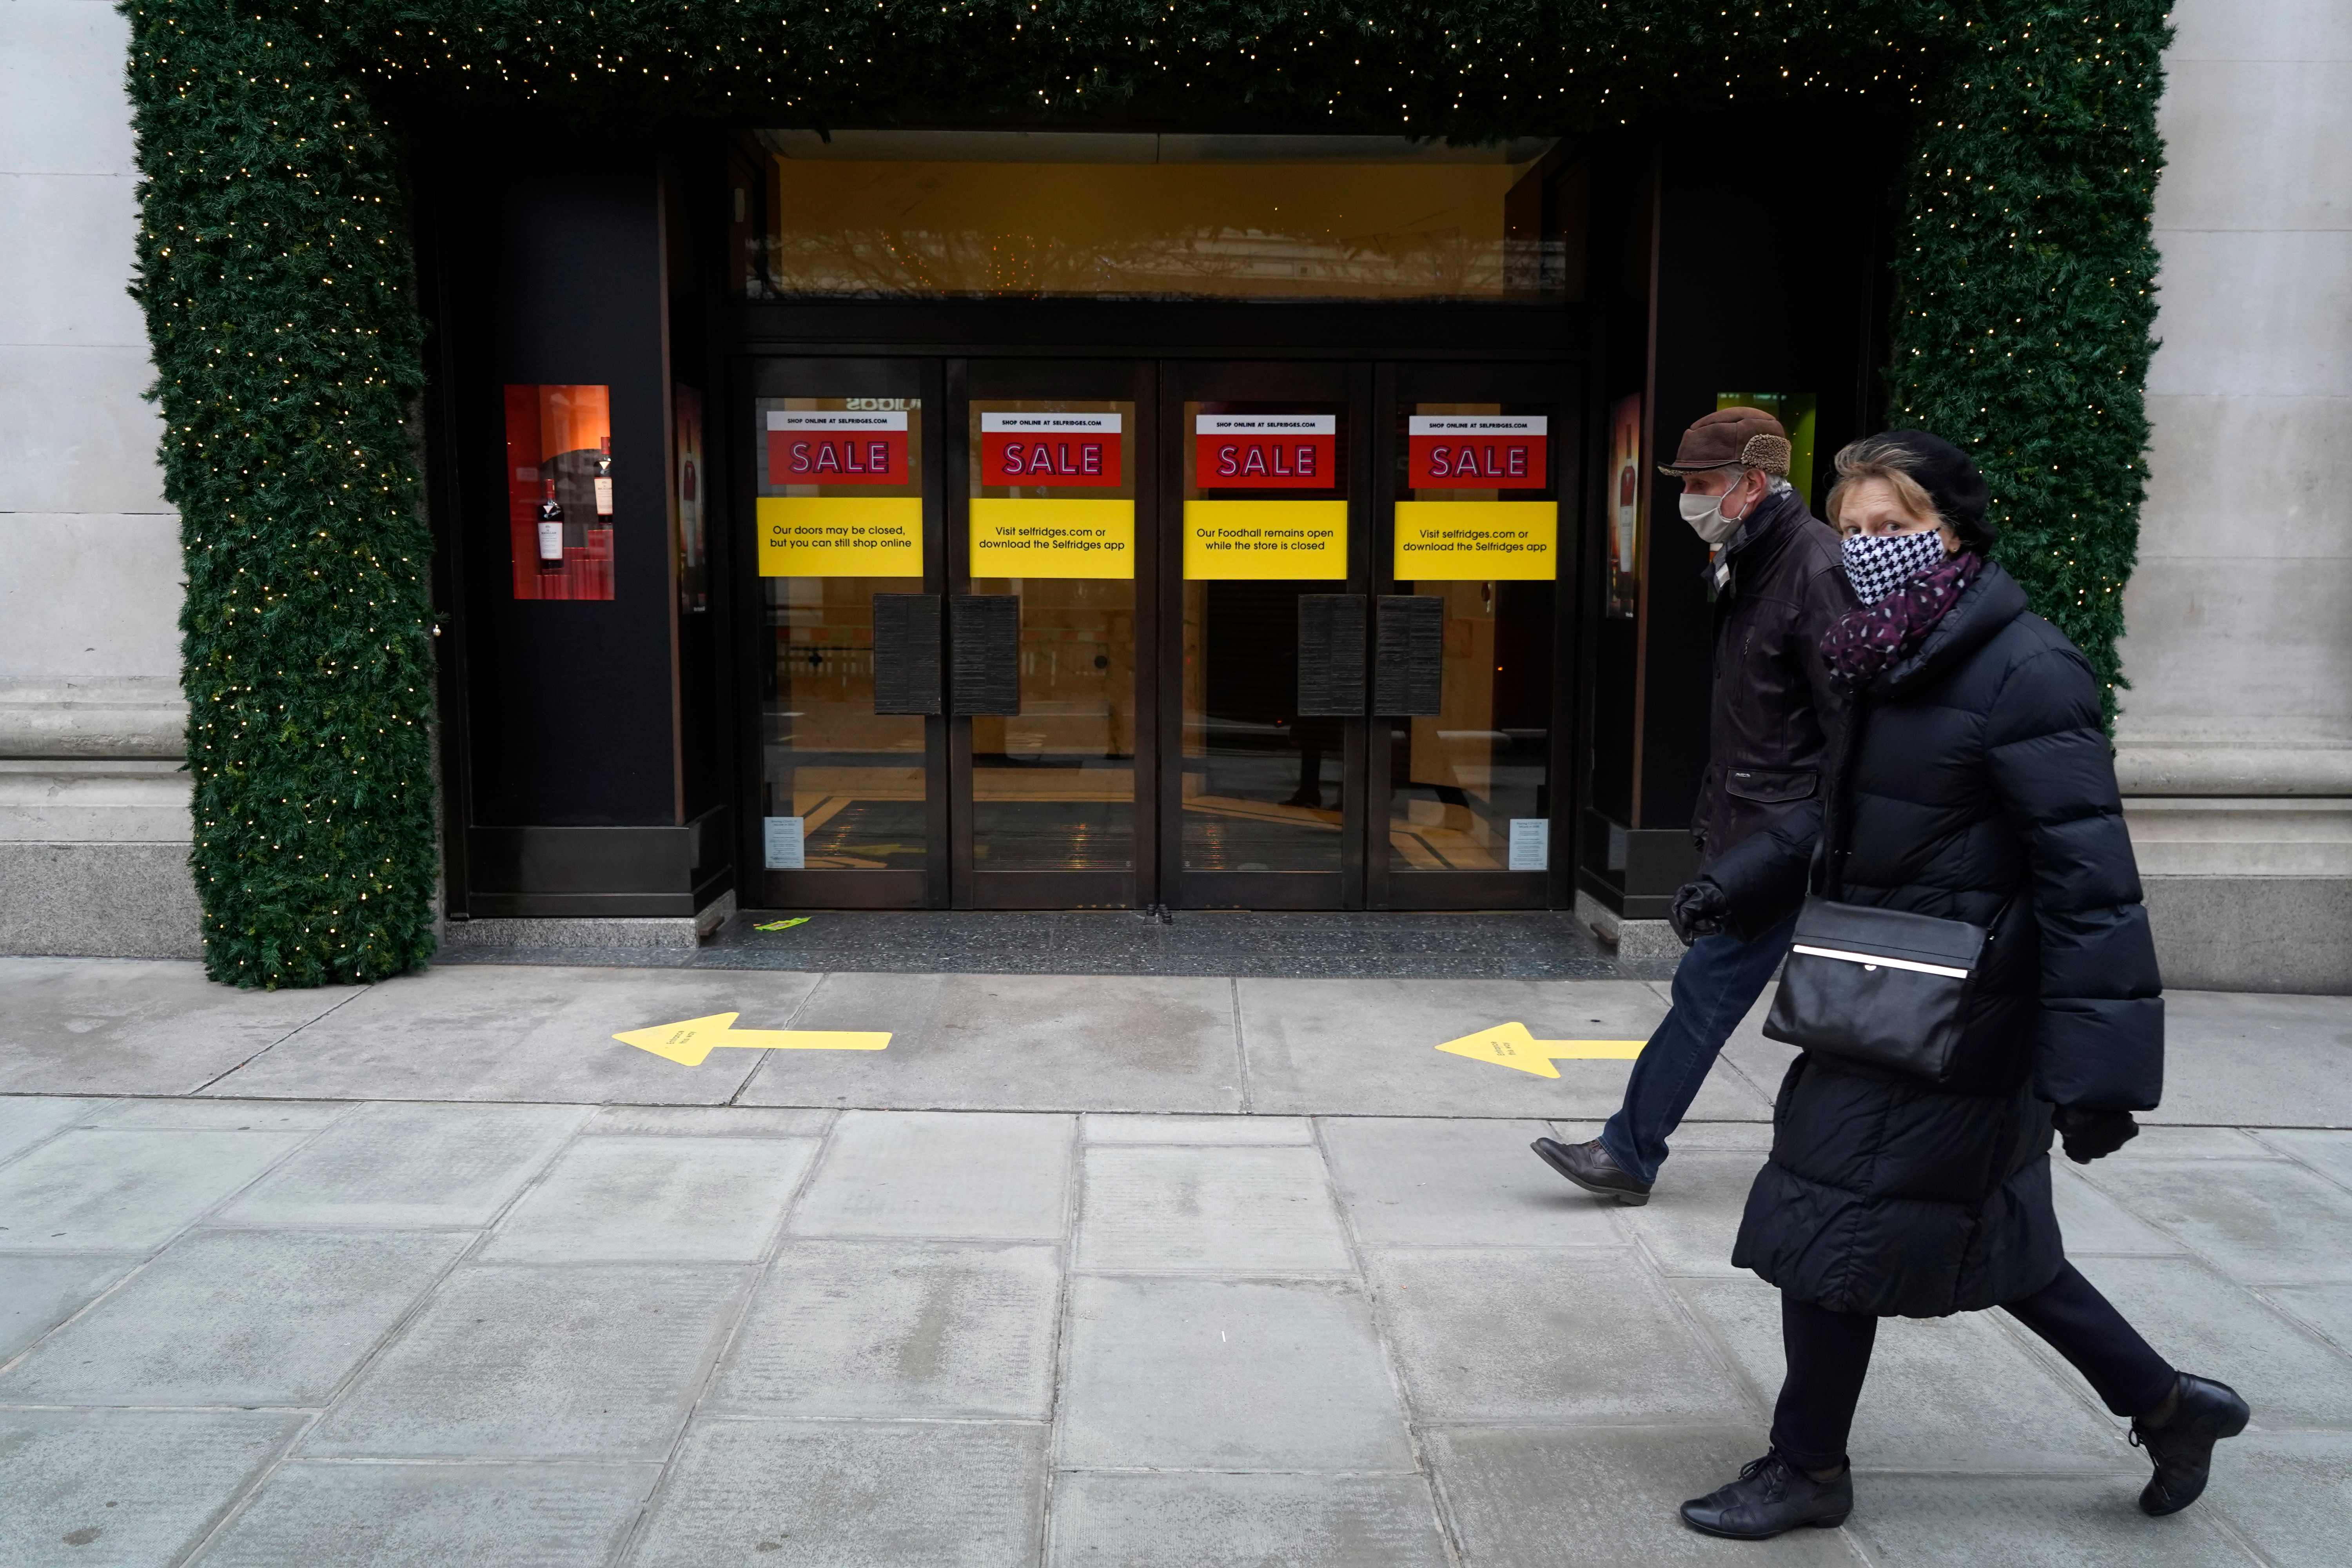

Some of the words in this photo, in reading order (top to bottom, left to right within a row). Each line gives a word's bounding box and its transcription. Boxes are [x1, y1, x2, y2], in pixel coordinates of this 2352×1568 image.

[789, 441, 889, 473] SALE
[1002, 443, 1102, 475] SALE
[1216, 445, 1316, 477] SALE
[1428, 445, 1528, 477] SALE
[773, 525, 791, 534] Our
[795, 526, 823, 534] doors
[826, 528, 848, 536] may
[852, 526, 865, 534] be
[868, 526, 905, 535] closed,
[995, 527, 1016, 535] Visit
[1019, 527, 1092, 538] selfridges.com
[1197, 528, 1215, 537] Our
[1218, 528, 1261, 537] Foodhall
[1265, 529, 1304, 537] remains
[1307, 530, 1333, 539] open
[1420, 530, 1439, 538] Visit
[1442, 530, 1515, 540] selfridges.com
[770, 538, 787, 547] but
[789, 540, 808, 549] you
[835, 539, 849, 547] still
[853, 539, 877, 549] shop
[881, 539, 911, 547] online
[979, 539, 1030, 548] download
[1033, 540, 1049, 548] the
[1053, 540, 1101, 551] Selfridges
[1104, 542, 1125, 551] app
[1205, 541, 1232, 550] while
[1234, 541, 1250, 550] the
[1254, 541, 1278, 550] store
[1281, 541, 1288, 550] is
[1291, 541, 1325, 550] closed
[1403, 543, 1454, 551] download
[1457, 543, 1473, 551] the
[1476, 542, 1524, 553] Selfridges
[1526, 544, 1547, 552] app
